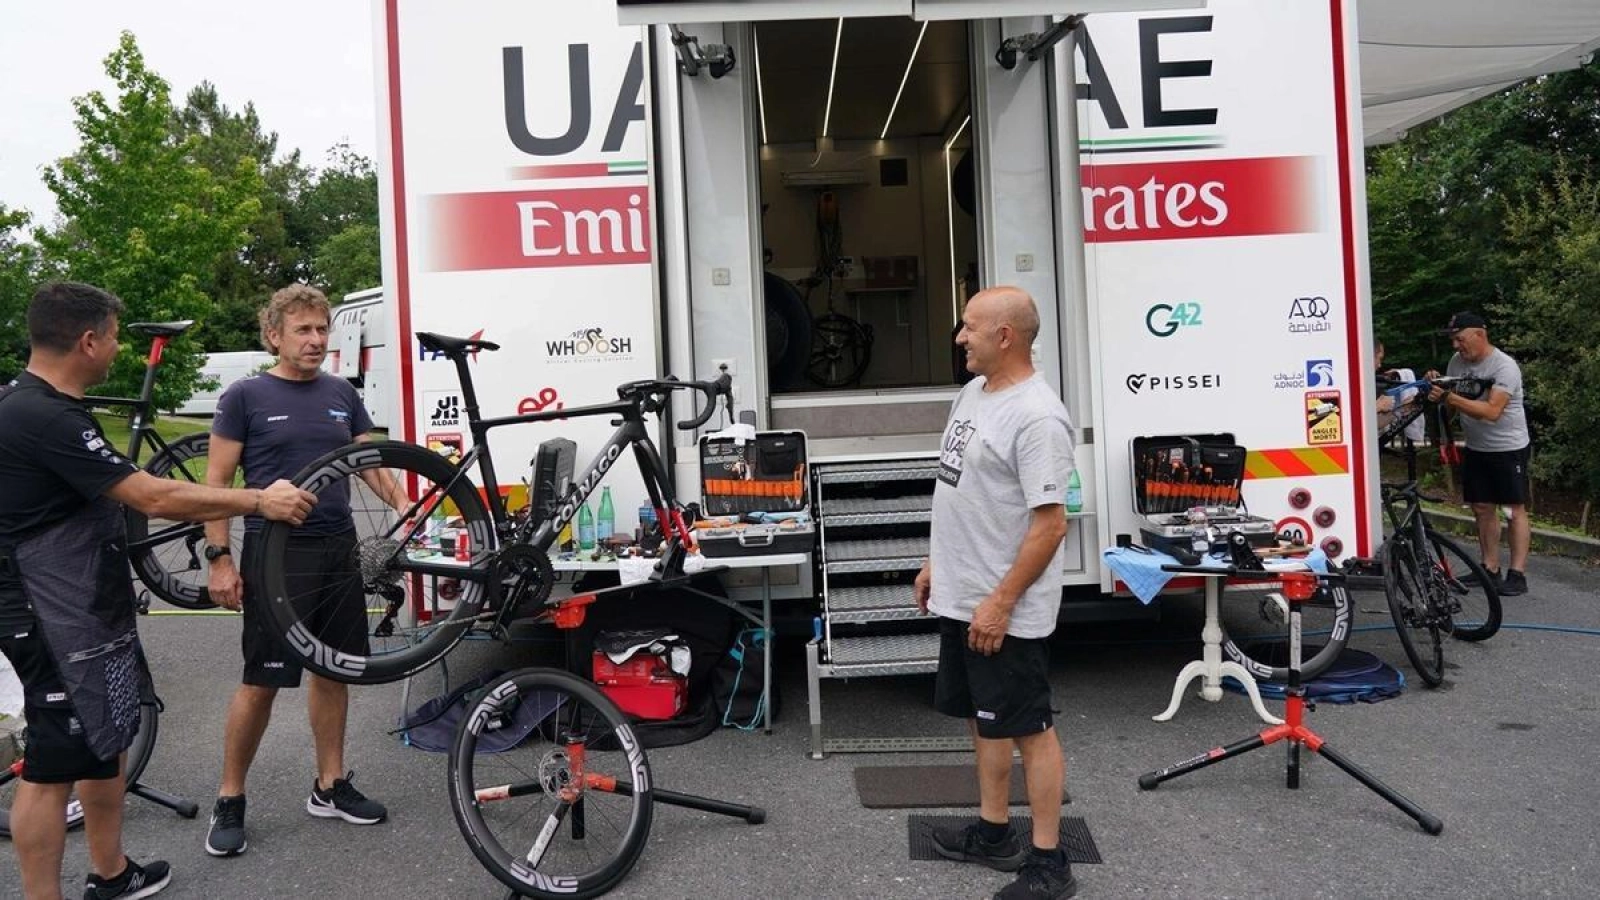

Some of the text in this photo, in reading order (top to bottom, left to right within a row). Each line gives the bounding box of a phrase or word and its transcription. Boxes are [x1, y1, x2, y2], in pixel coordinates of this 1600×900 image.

[1082, 175, 1228, 232] rates
[516, 194, 648, 257] Emi
[1146, 302, 1202, 337] G42
[1289, 296, 1330, 319] ADQ
[546, 337, 631, 356] WHOOSH
[1150, 374, 1221, 390] PISSEI
[1275, 381, 1305, 389] ADNOC
[552, 443, 620, 533] COLNAGO
